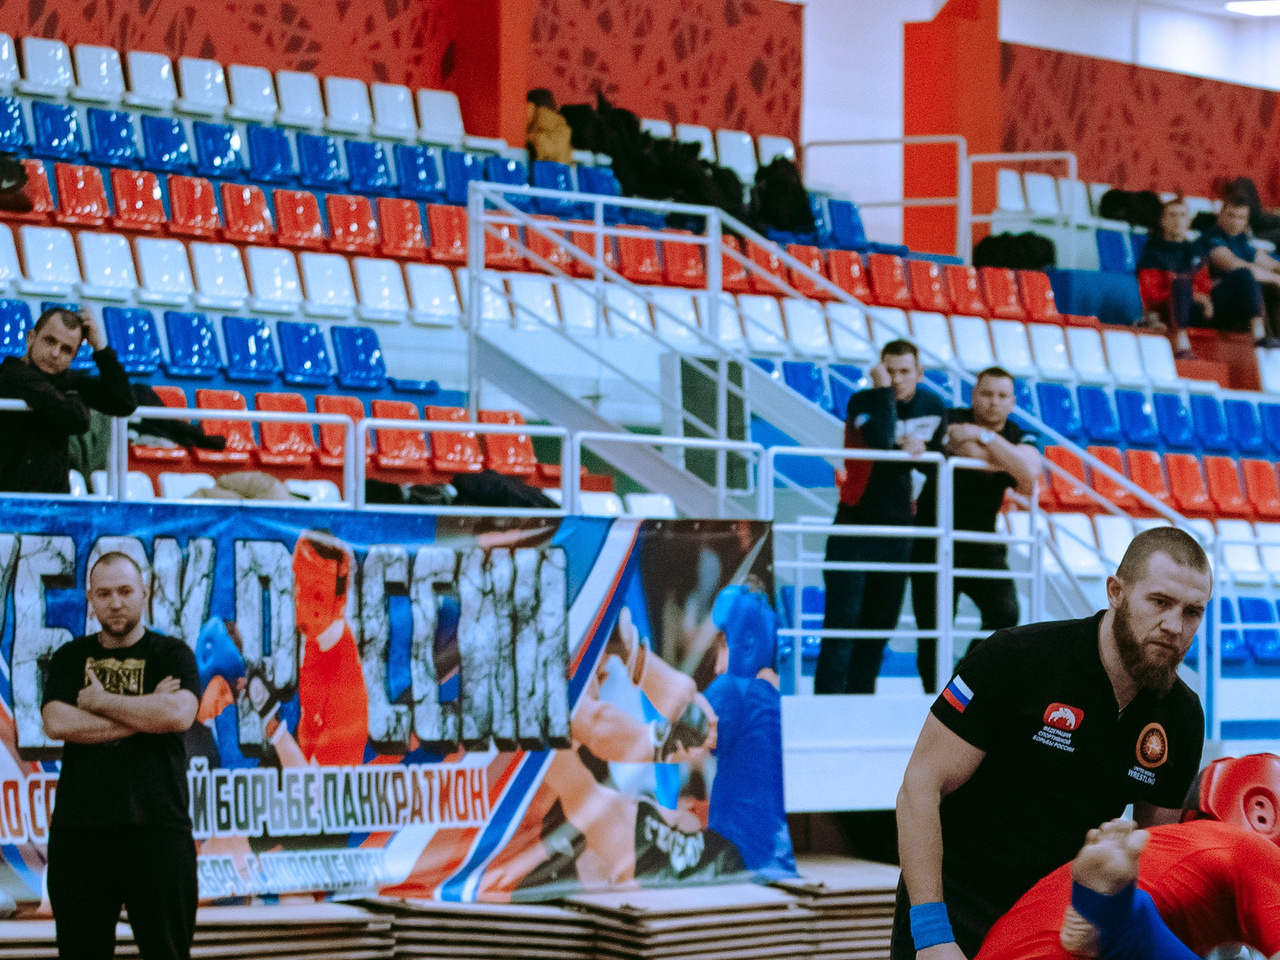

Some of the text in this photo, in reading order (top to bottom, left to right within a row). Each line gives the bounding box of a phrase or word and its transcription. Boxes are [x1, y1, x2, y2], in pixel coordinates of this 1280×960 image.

[234, 538, 571, 753] РССИИ
[214, 772, 319, 833] БОРЬБЕ
[322, 766, 488, 828] ПАНКРАТИОН
[1127, 769, 1156, 785] WRESTLING
